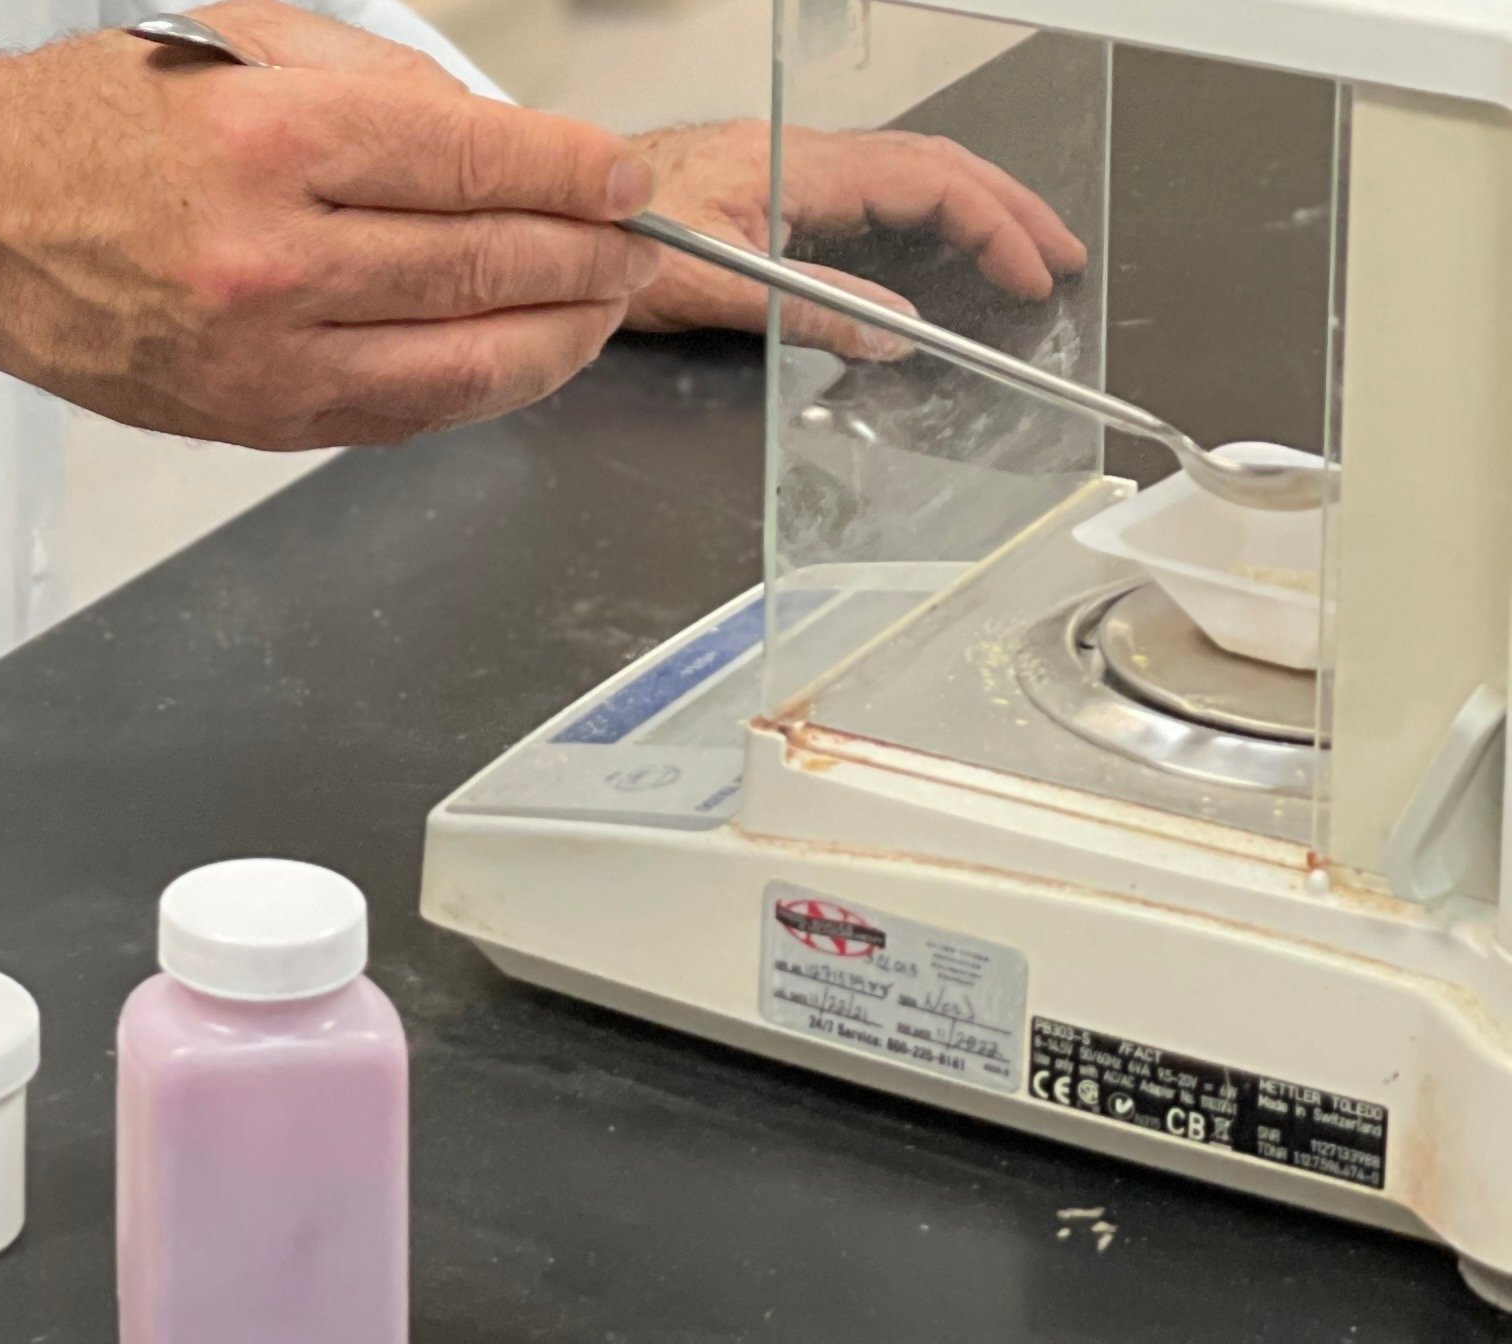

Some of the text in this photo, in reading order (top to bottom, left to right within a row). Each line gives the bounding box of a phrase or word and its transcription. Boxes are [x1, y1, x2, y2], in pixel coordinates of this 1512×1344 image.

[809, 1014, 834, 1033] 24/7
[837, 1023, 884, 1047] Service:
[1257, 1094, 1289, 1113] Made
[1294, 1106, 1306, 1120] in
[1313, 1107, 1383, 1138] Switzerland
[1258, 1078, 1321, 1105] METTLER
[1333, 1095, 1384, 1120] TOLEDO
